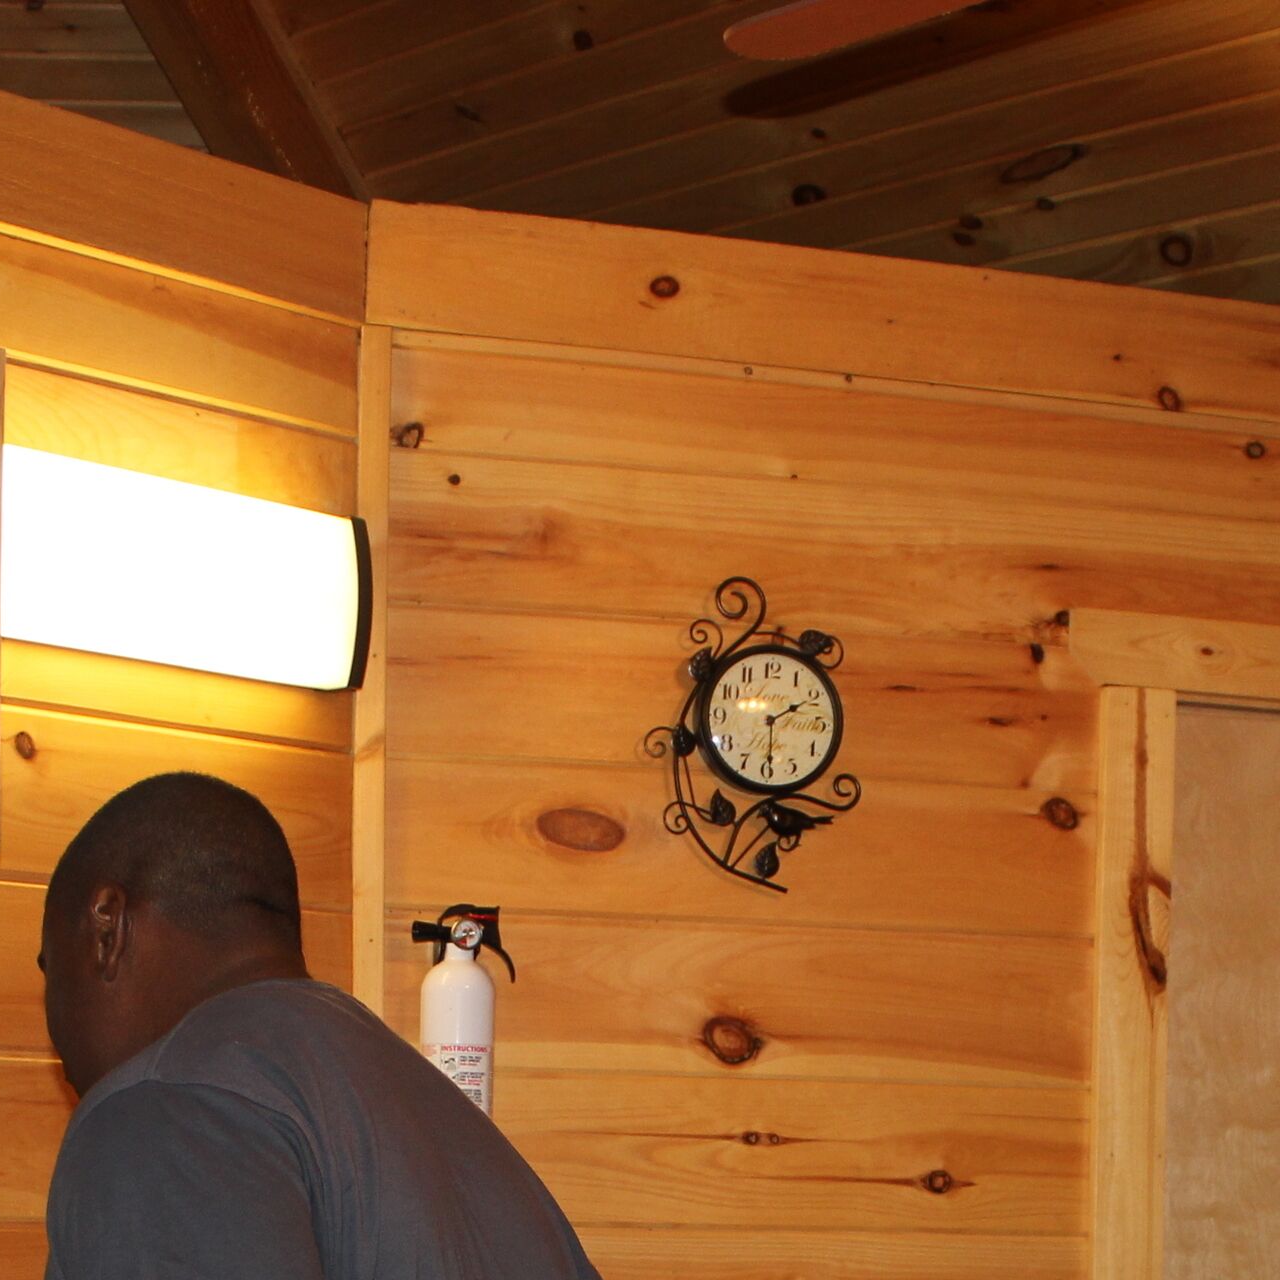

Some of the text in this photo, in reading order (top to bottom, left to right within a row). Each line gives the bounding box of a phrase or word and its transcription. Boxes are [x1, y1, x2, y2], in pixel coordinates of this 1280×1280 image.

[742, 666, 753, 684] 11
[765, 662, 782, 680] 12
[794, 670, 800, 688] 1
[723, 684, 740, 700] 10
[808, 689, 820, 707] 2
[713, 707, 727, 724] 9
[721, 734, 733, 752] 8
[740, 753, 750, 770] 7
[761, 761, 774, 779] 6
[786, 758, 798, 775] 5
[441, 1045, 488, 1053] INSTRUCTIONS
